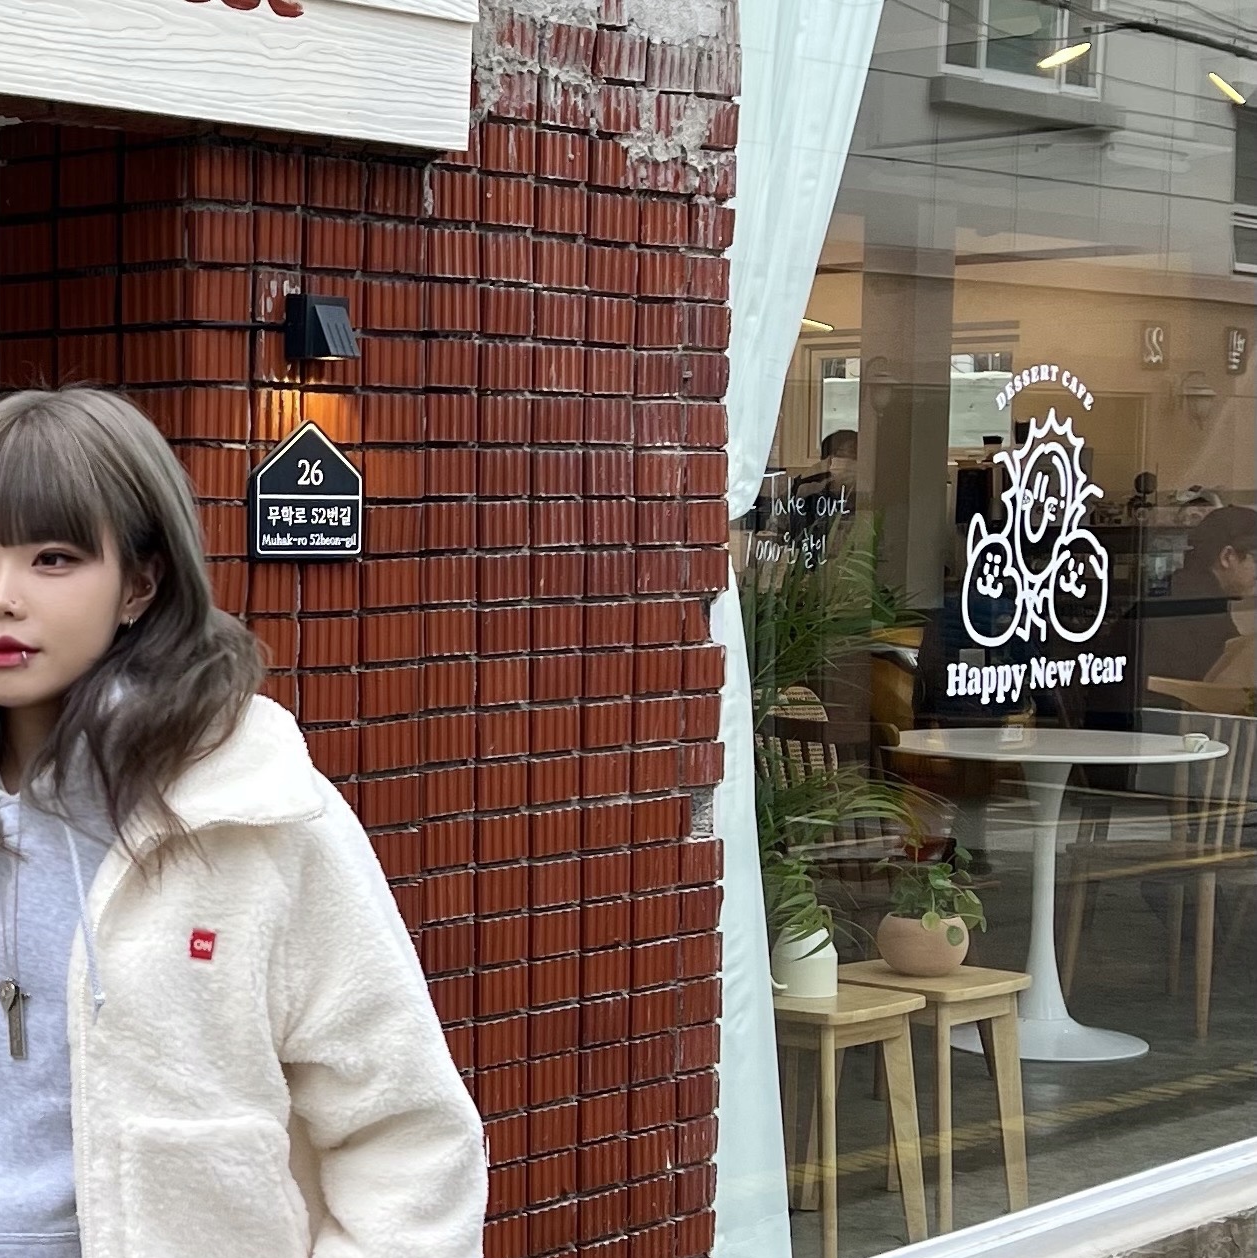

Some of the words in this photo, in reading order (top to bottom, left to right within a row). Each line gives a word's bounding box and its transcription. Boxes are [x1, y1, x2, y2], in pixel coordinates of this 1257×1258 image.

[996, 365, 1059, 410] DESSERT
[1062, 371, 1094, 410] CAFE
[298, 459, 323, 485] 26
[763, 470, 807, 516] Take
[816, 484, 850, 517] out
[267, 506, 308, 526] 무학로
[311, 506, 351, 526] 52번길
[262, 533, 307, 546] Muhak-ro
[309, 533, 357, 548] 52beon-gil
[947, 663, 1027, 704] Happy
[1030, 656, 1075, 690] New
[1078, 652, 1127, 685] Year
